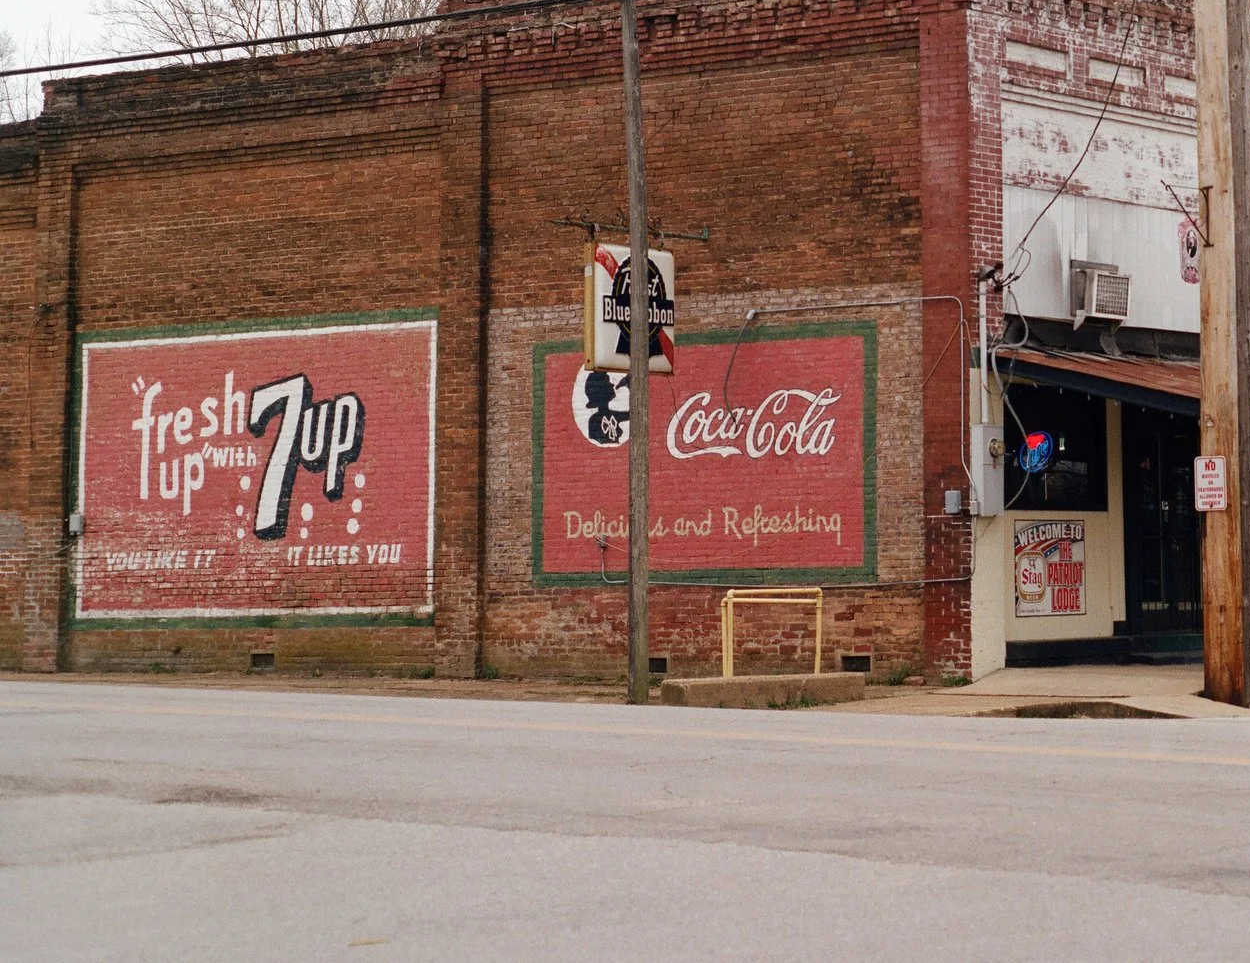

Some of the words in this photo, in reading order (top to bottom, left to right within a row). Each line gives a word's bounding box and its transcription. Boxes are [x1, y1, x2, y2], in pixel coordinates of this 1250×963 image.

[620, 266, 660, 298] Pst
[604, 297, 631, 322] Blue
[666, 387, 842, 460] Coca-Cola
[1204, 461, 1216, 471] NO
[563, 510, 669, 539] Delicis
[674, 509, 712, 536] and
[722, 504, 842, 546] Refreshing
[1018, 523, 1068, 548] WELCOME
[1069, 524, 1083, 540] TO
[287, 546, 304, 567] IT
[306, 545, 361, 567] LIKES
[366, 543, 402, 565] YOU
[1058, 541, 1073, 562] THE
[1022, 568, 1043, 589] Stag
[1047, 561, 1084, 587] PATRIOT
[1051, 587, 1081, 612] LODGE
